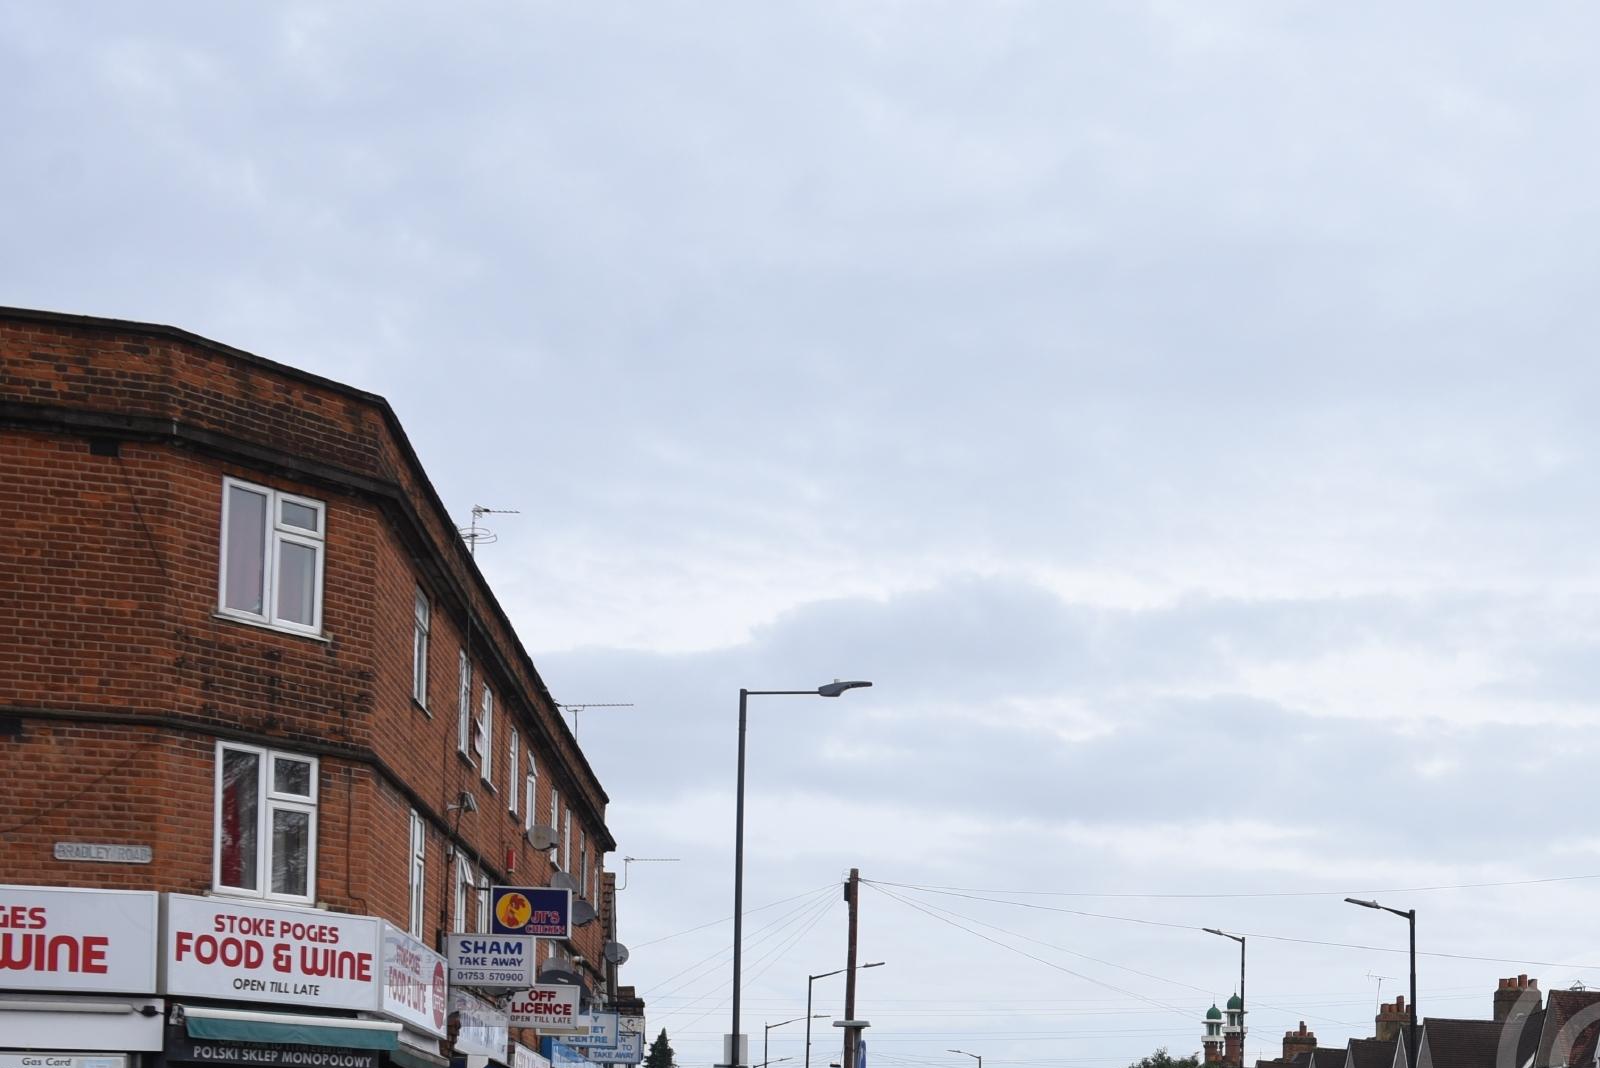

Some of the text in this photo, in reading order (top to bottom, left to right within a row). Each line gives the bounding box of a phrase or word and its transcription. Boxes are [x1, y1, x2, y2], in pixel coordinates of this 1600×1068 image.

[57, 844, 111, 859] BRADLEY
[214, 914, 339, 944] STOKE POGES
[0, 933, 109, 974] WINE
[460, 940, 523, 955] SHAM
[175, 931, 264, 969] FOOD
[273, 943, 292, 973] &
[300, 945, 373, 982] WINE
[458, 956, 524, 967] TAKE AWAY
[457, 971, 524, 982] 01753 570900
[233, 978, 320, 996] OPEN TILL LATE
[528, 990, 557, 1002] OFF
[511, 1002, 572, 1016] LICENCE
[510, 1015, 572, 1025] OPEN TILL LATE
[22, 1057, 72, 1066] Gas Card
[193, 1046, 239, 1060] POLSKI
[242, 1050, 278, 1062] SKLEP
[281, 1054, 372, 1068] MONOPOLOWY
